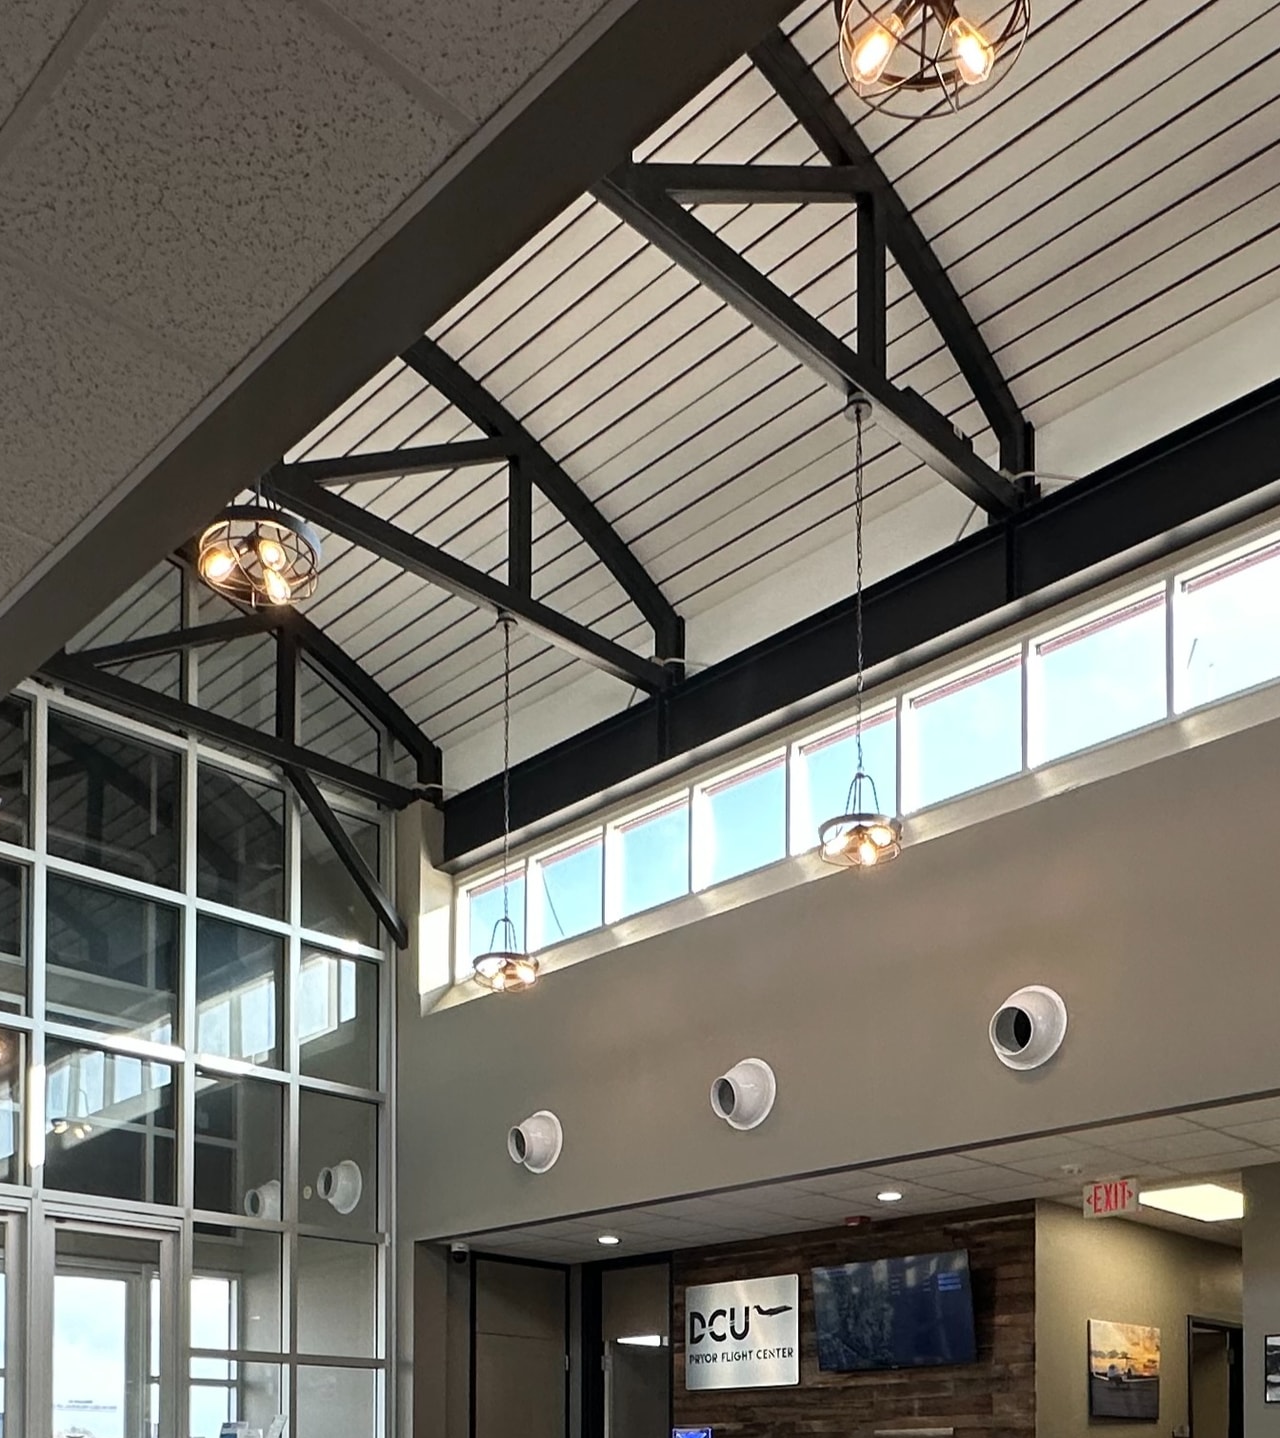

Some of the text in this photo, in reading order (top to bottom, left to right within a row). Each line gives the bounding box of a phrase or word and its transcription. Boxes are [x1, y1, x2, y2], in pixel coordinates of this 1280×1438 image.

[1093, 1181, 1128, 1213] EXIT
[689, 1305, 750, 1345] DCU
[689, 1347, 794, 1365] PRYOR FLIGHT CENTER
